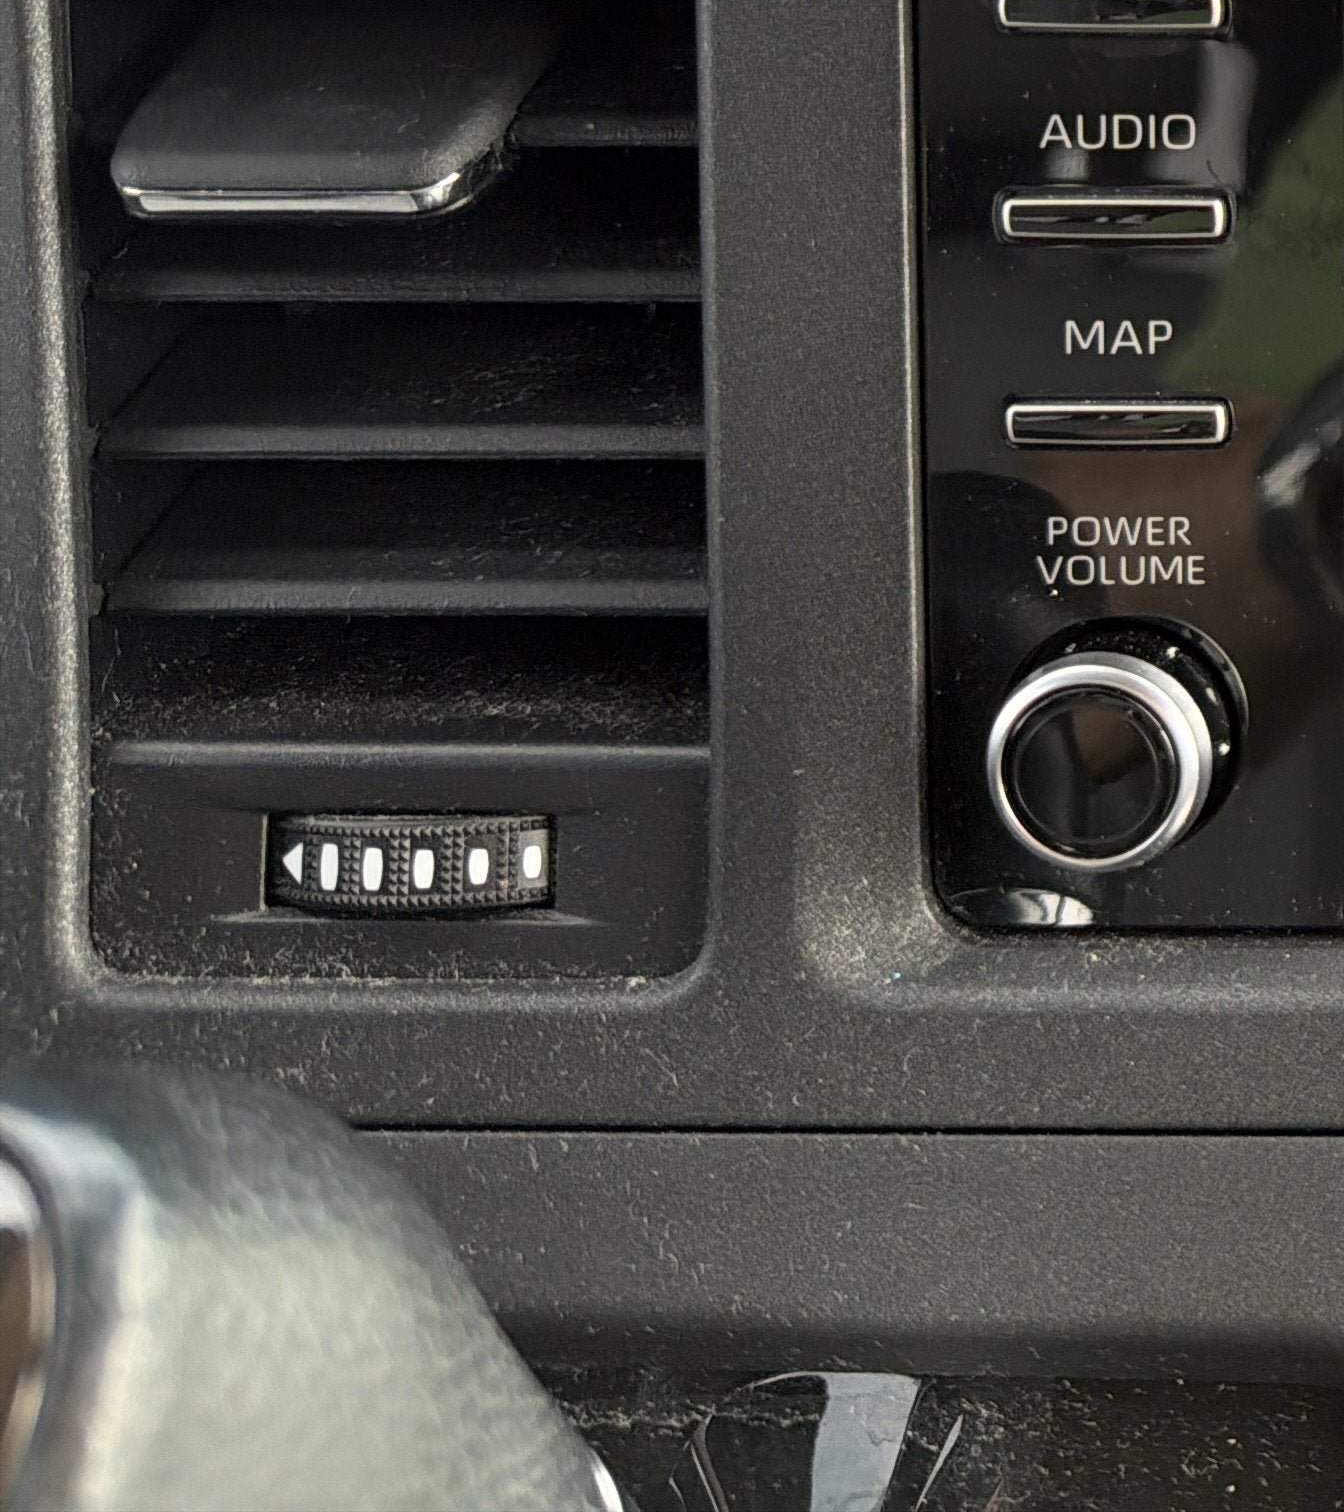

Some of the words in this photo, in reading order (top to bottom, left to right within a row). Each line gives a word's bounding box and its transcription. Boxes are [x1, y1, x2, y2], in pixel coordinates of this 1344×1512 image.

[1040, 113, 1198, 152] AUDIO
[1064, 319, 1173, 356] MAP
[1046, 515, 1192, 547] POWER
[1037, 554, 1206, 587] VOLUME
